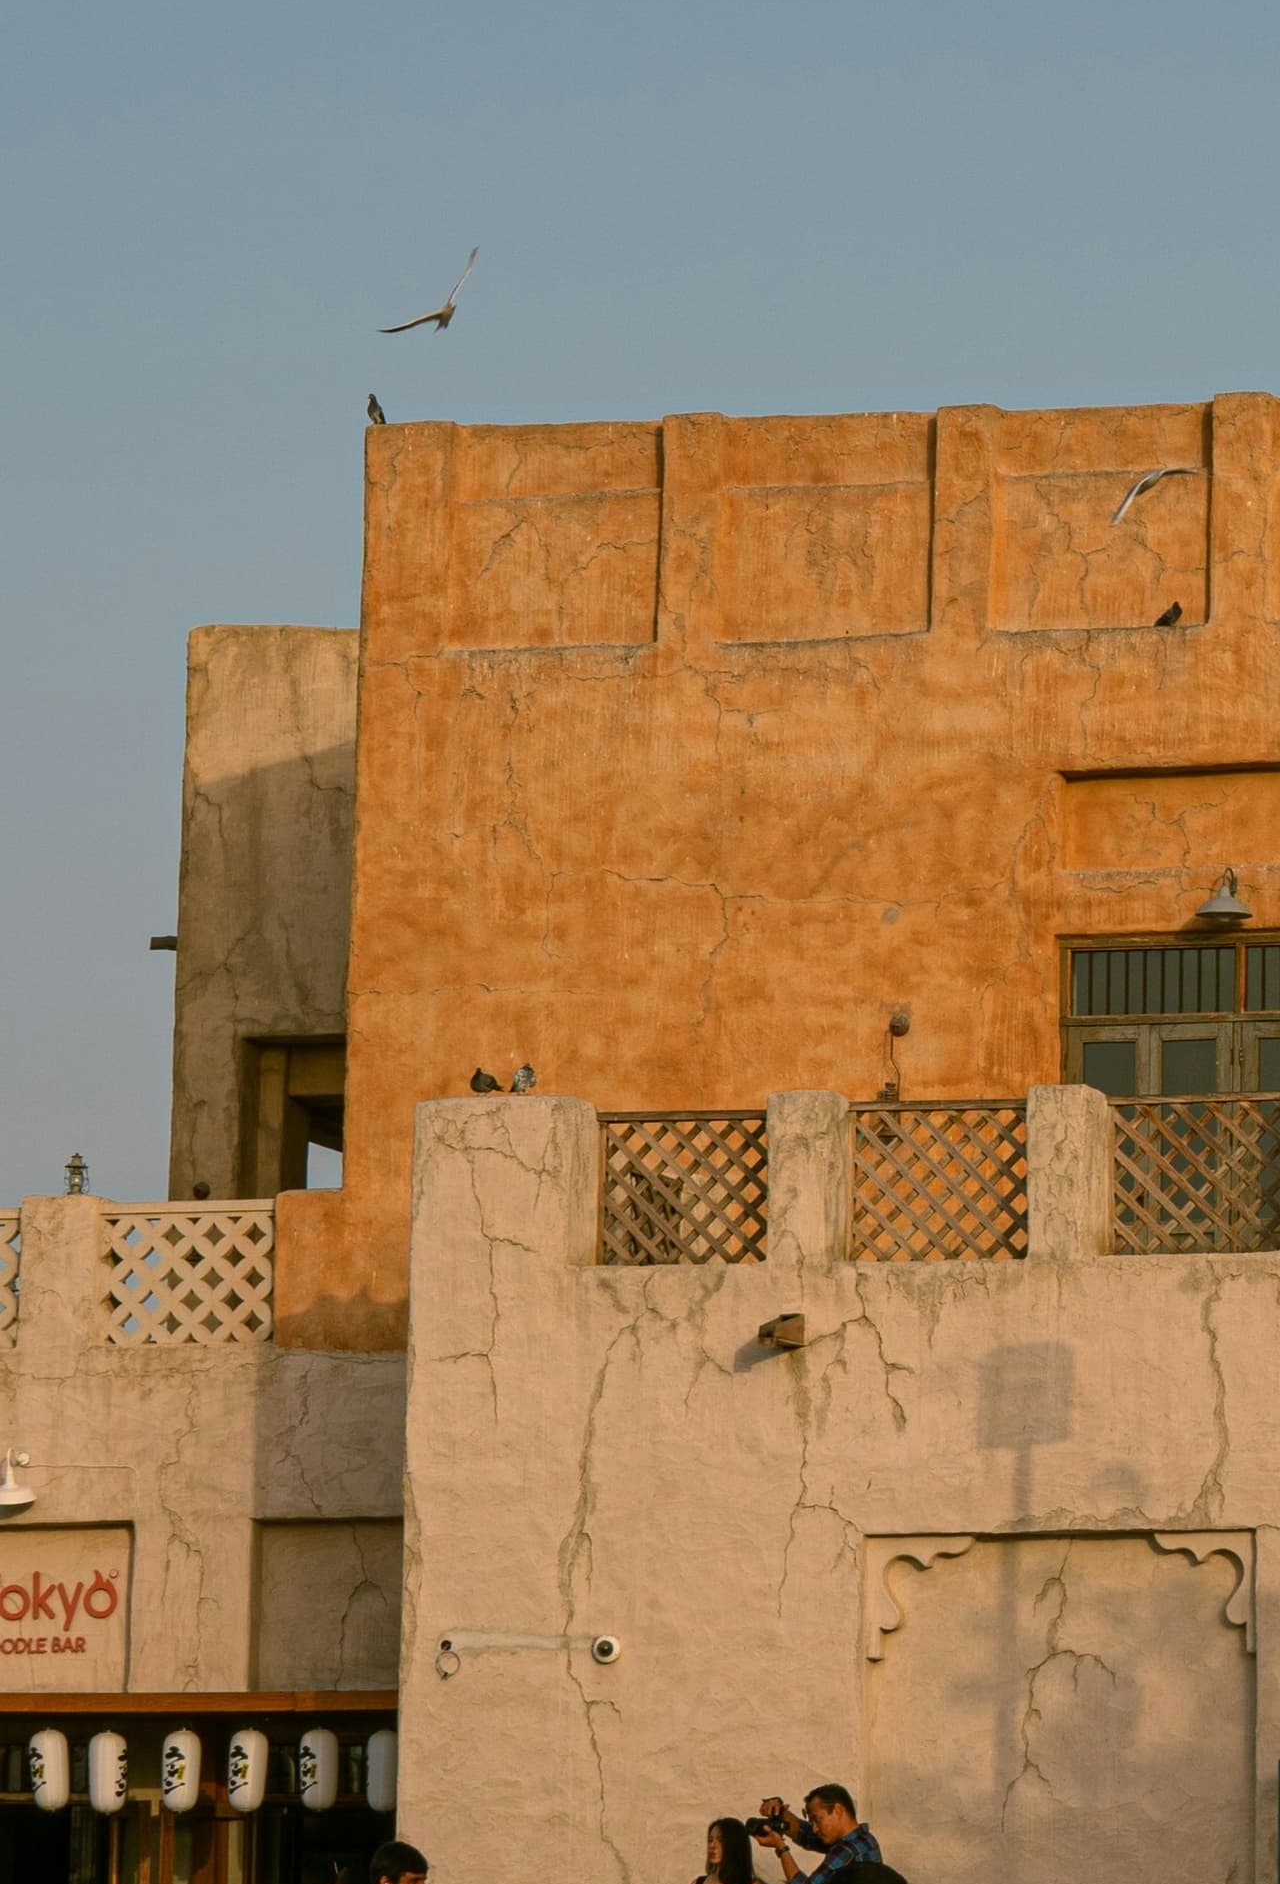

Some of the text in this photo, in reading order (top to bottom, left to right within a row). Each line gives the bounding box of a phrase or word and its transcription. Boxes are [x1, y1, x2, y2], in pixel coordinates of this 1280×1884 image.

[0, 1569, 118, 1632] okyo
[0, 1636, 86, 1654] ODLE BAR
